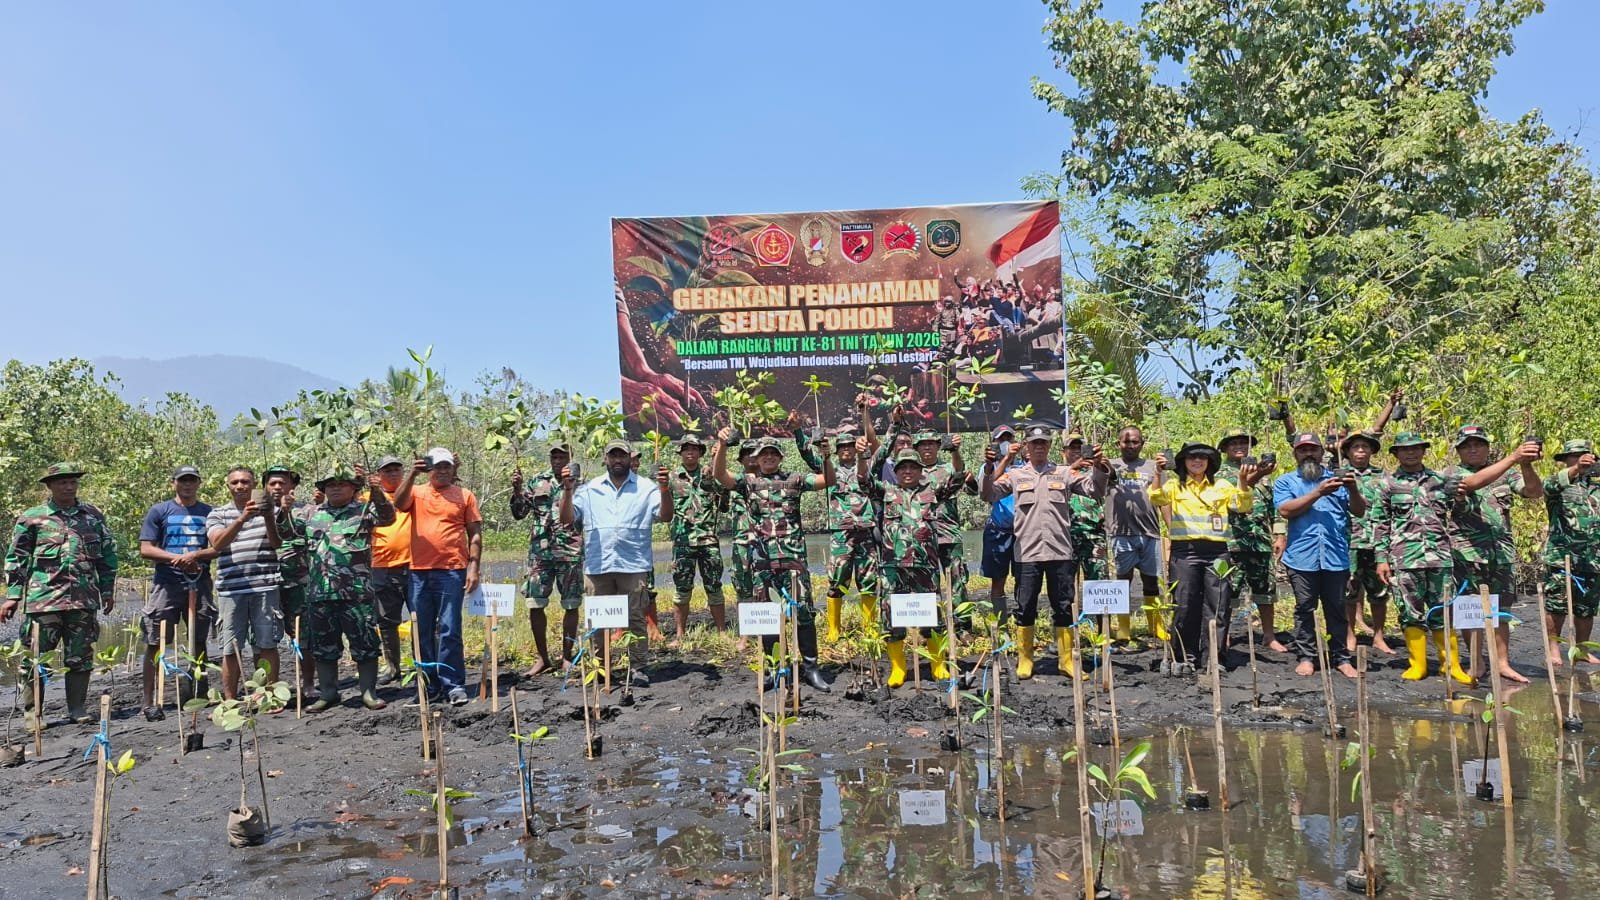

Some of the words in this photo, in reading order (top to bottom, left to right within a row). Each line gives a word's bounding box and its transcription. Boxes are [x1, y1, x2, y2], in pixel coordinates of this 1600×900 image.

[673, 285, 786, 311] GERAKAN
[790, 279, 939, 306] PENANAMAN
[719, 310, 806, 334] SEJUTA
[808, 306, 894, 331] POHON
[677, 339, 718, 355] DALAM
[721, 338, 771, 354] RANGKA
[774, 337, 799, 352] HUT
[802, 336, 835, 352] KE-81
[838, 335, 859, 350] TNI
[907, 332, 940, 347] 2026
[748, 355, 798, 369] Wujudkan
[800, 354, 849, 366] Indonesia
[1088, 588, 1123, 596] KAPOLSEK
[1093, 597, 1118, 605] GALELA
[589, 608, 602, 616] PT.
[605, 607, 623, 616] NHM
